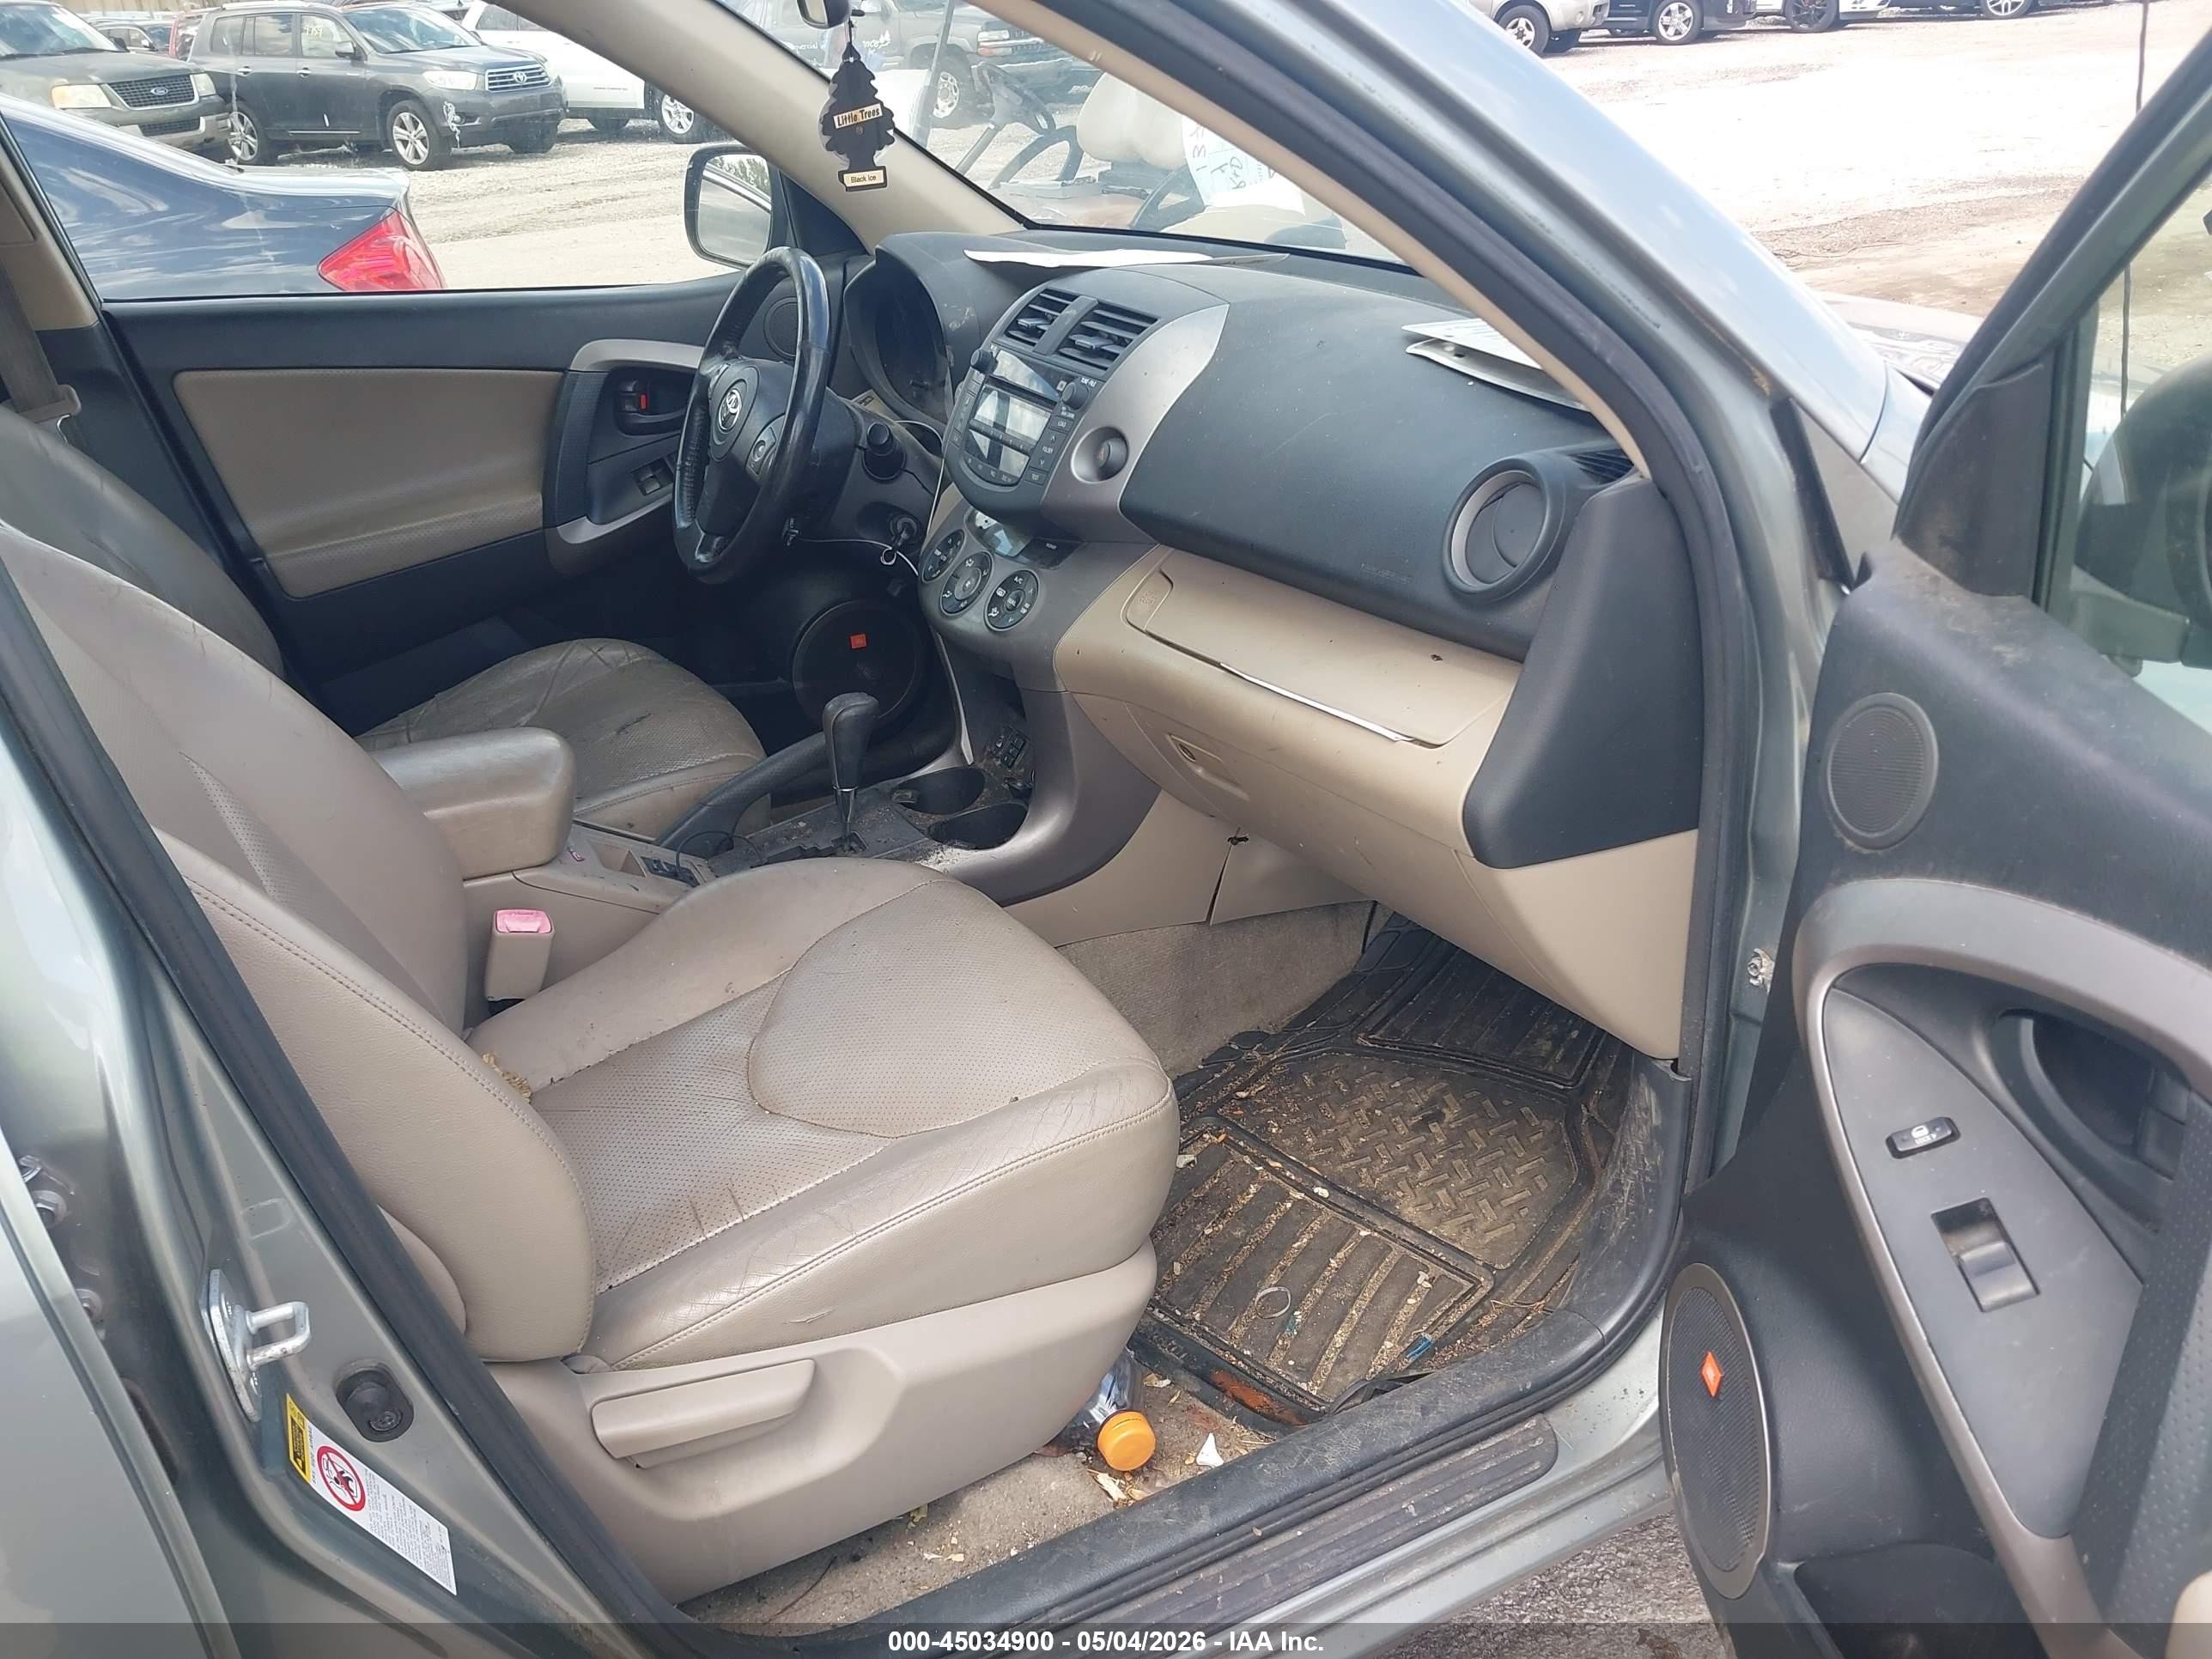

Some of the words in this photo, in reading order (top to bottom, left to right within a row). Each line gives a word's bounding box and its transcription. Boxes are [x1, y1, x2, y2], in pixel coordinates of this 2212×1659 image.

[837, 112, 858, 127] Little
[859, 108, 880, 120] Trees
[850, 175, 867, 184] Black
